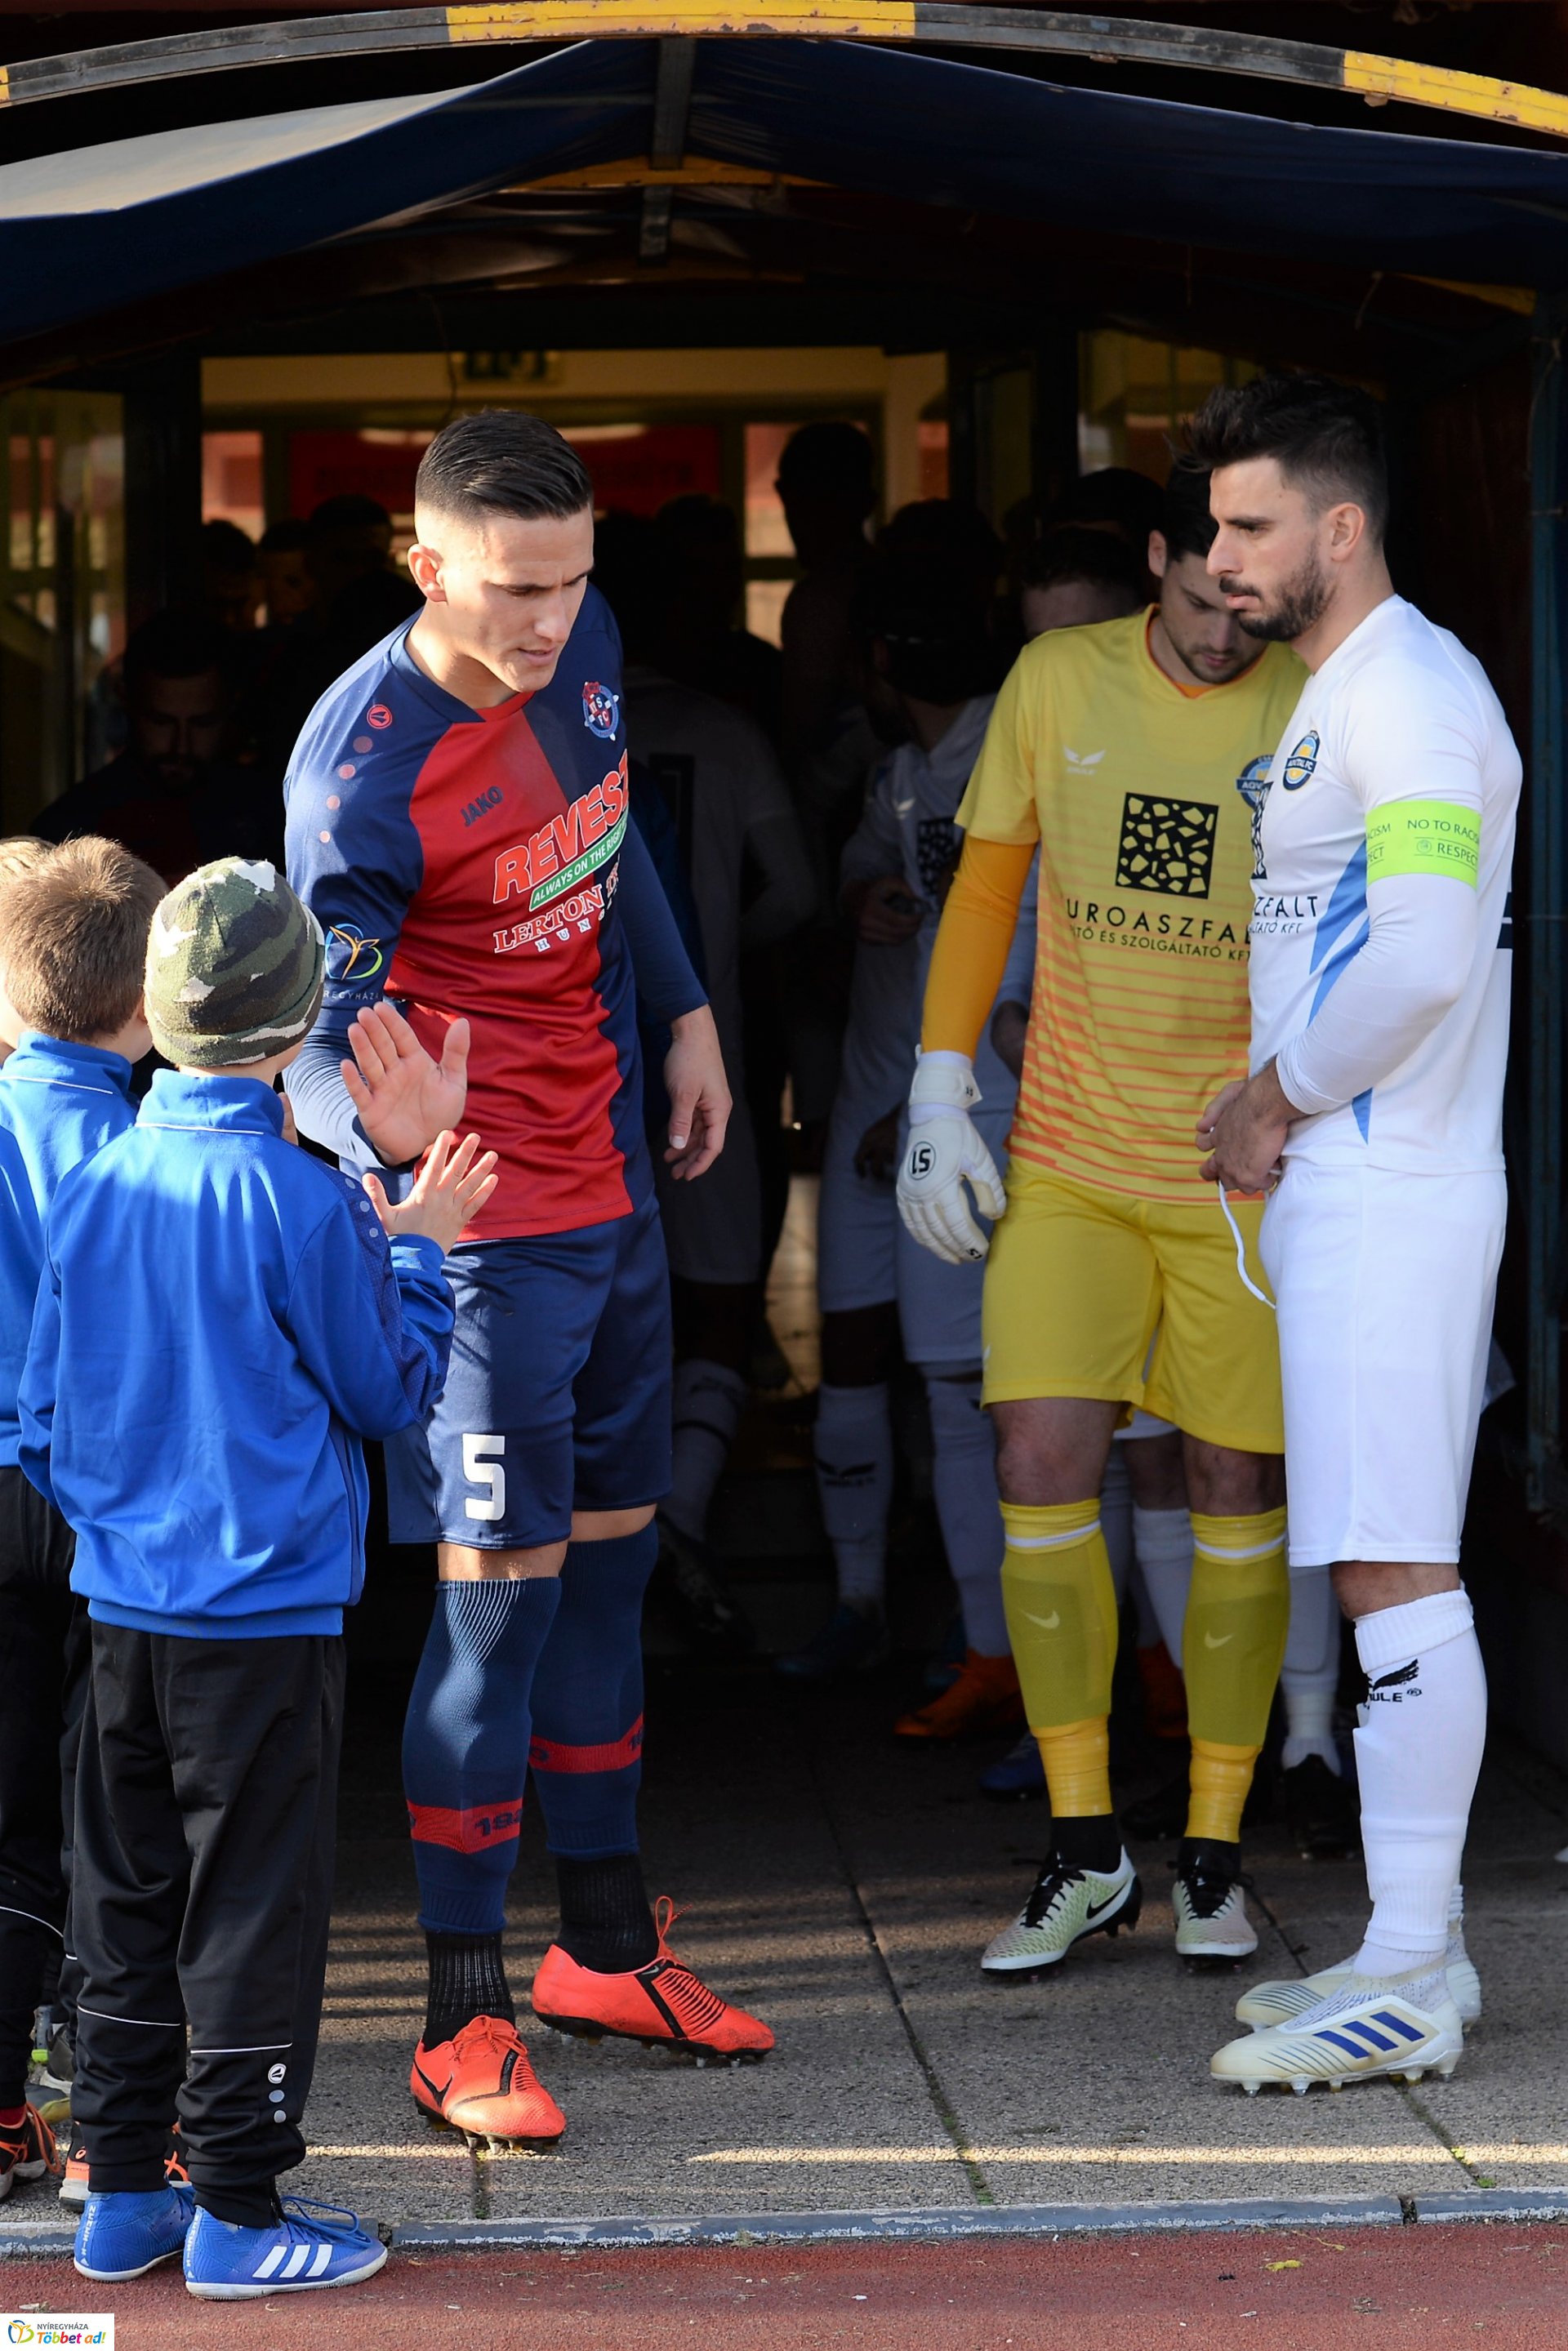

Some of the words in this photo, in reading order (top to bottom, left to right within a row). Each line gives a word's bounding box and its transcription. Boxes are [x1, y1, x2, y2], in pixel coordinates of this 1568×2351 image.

[460, 786, 504, 827] JAKO
[1408, 819, 1429, 830] NO
[1433, 820, 1450, 831] TO
[1368, 846, 1384, 862] ECT
[533, 870, 572, 903] ALWAYS
[574, 860, 588, 875] ON
[589, 848, 606, 865] THE
[493, 884, 604, 953] LERTON
[1281, 923, 1303, 933] KFT
[1100, 928, 1116, 943] ÉS
[1121, 934, 1222, 958] SZOLGÁLTATÓ
[912, 1148, 930, 1174] 15
[462, 1432, 506, 1521] 5
